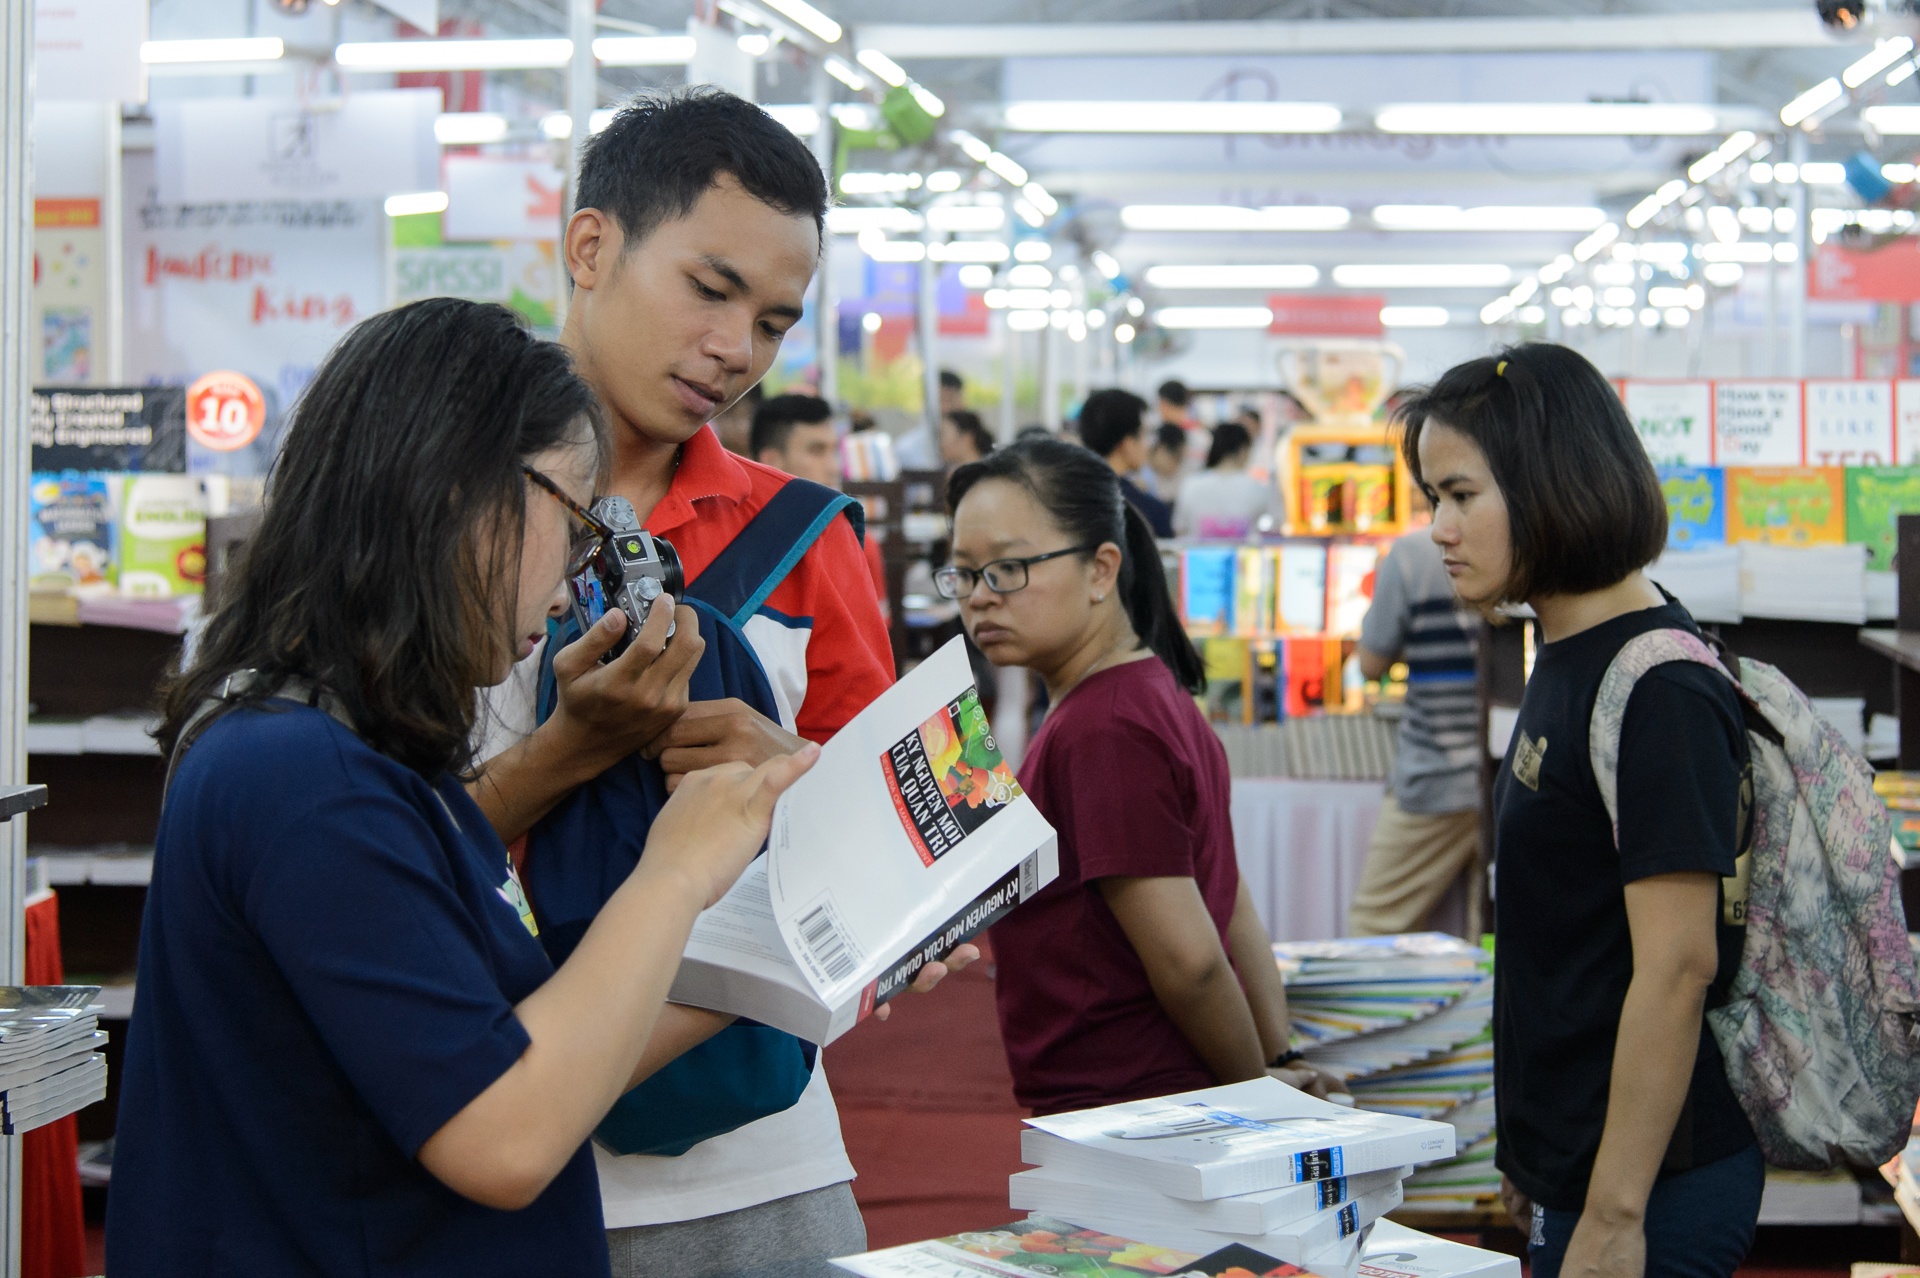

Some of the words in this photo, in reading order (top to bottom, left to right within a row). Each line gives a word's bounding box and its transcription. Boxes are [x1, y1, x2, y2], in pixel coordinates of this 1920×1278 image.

[52, 393, 143, 413] Structured
[1718, 388, 1761, 401] How
[200, 396, 248, 435] 10
[1819, 418, 1876, 433] LIKE
[55, 426, 152, 447] Engineered
[1640, 416, 1695, 437] NOT
[881, 754, 890, 774] NEW
[887, 774, 896, 794] ERA
[894, 795, 901, 807] OF
[899, 806, 932, 865] MANAGEMENT
[966, 889, 1005, 929] NGUYÊN
